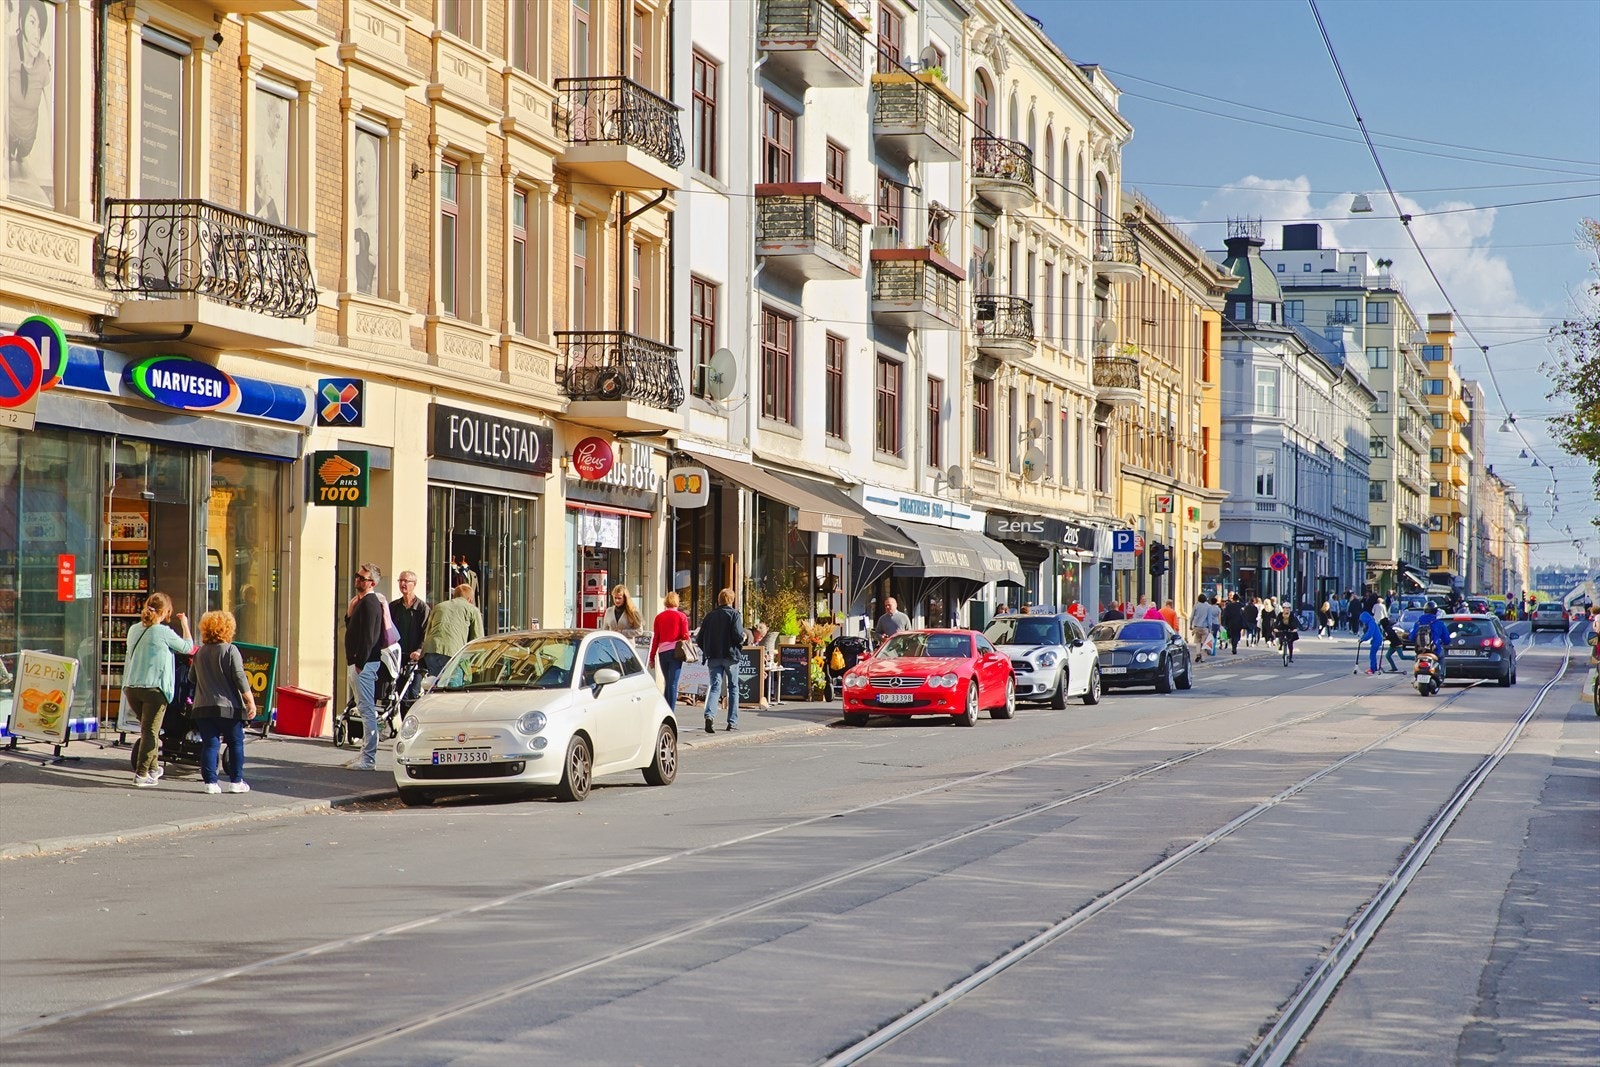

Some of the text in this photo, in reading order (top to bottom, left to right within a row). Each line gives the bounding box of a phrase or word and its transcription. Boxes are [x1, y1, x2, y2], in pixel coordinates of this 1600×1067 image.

[152, 368, 222, 399] NARVESEN
[9, 413, 18, 423] 12
[449, 414, 540, 464] FOLLESTAD
[577, 443, 607, 470] Preus
[631, 442, 655, 469] TIME
[630, 464, 657, 493] FOTO
[320, 486, 360, 502] TOTO
[1158, 497, 1170, 512] 7
[1117, 533, 1129, 550] P
[24, 662, 42, 676] 1/2
[43, 665, 65, 680] Pris
[440, 752, 488, 762] BR 73530
